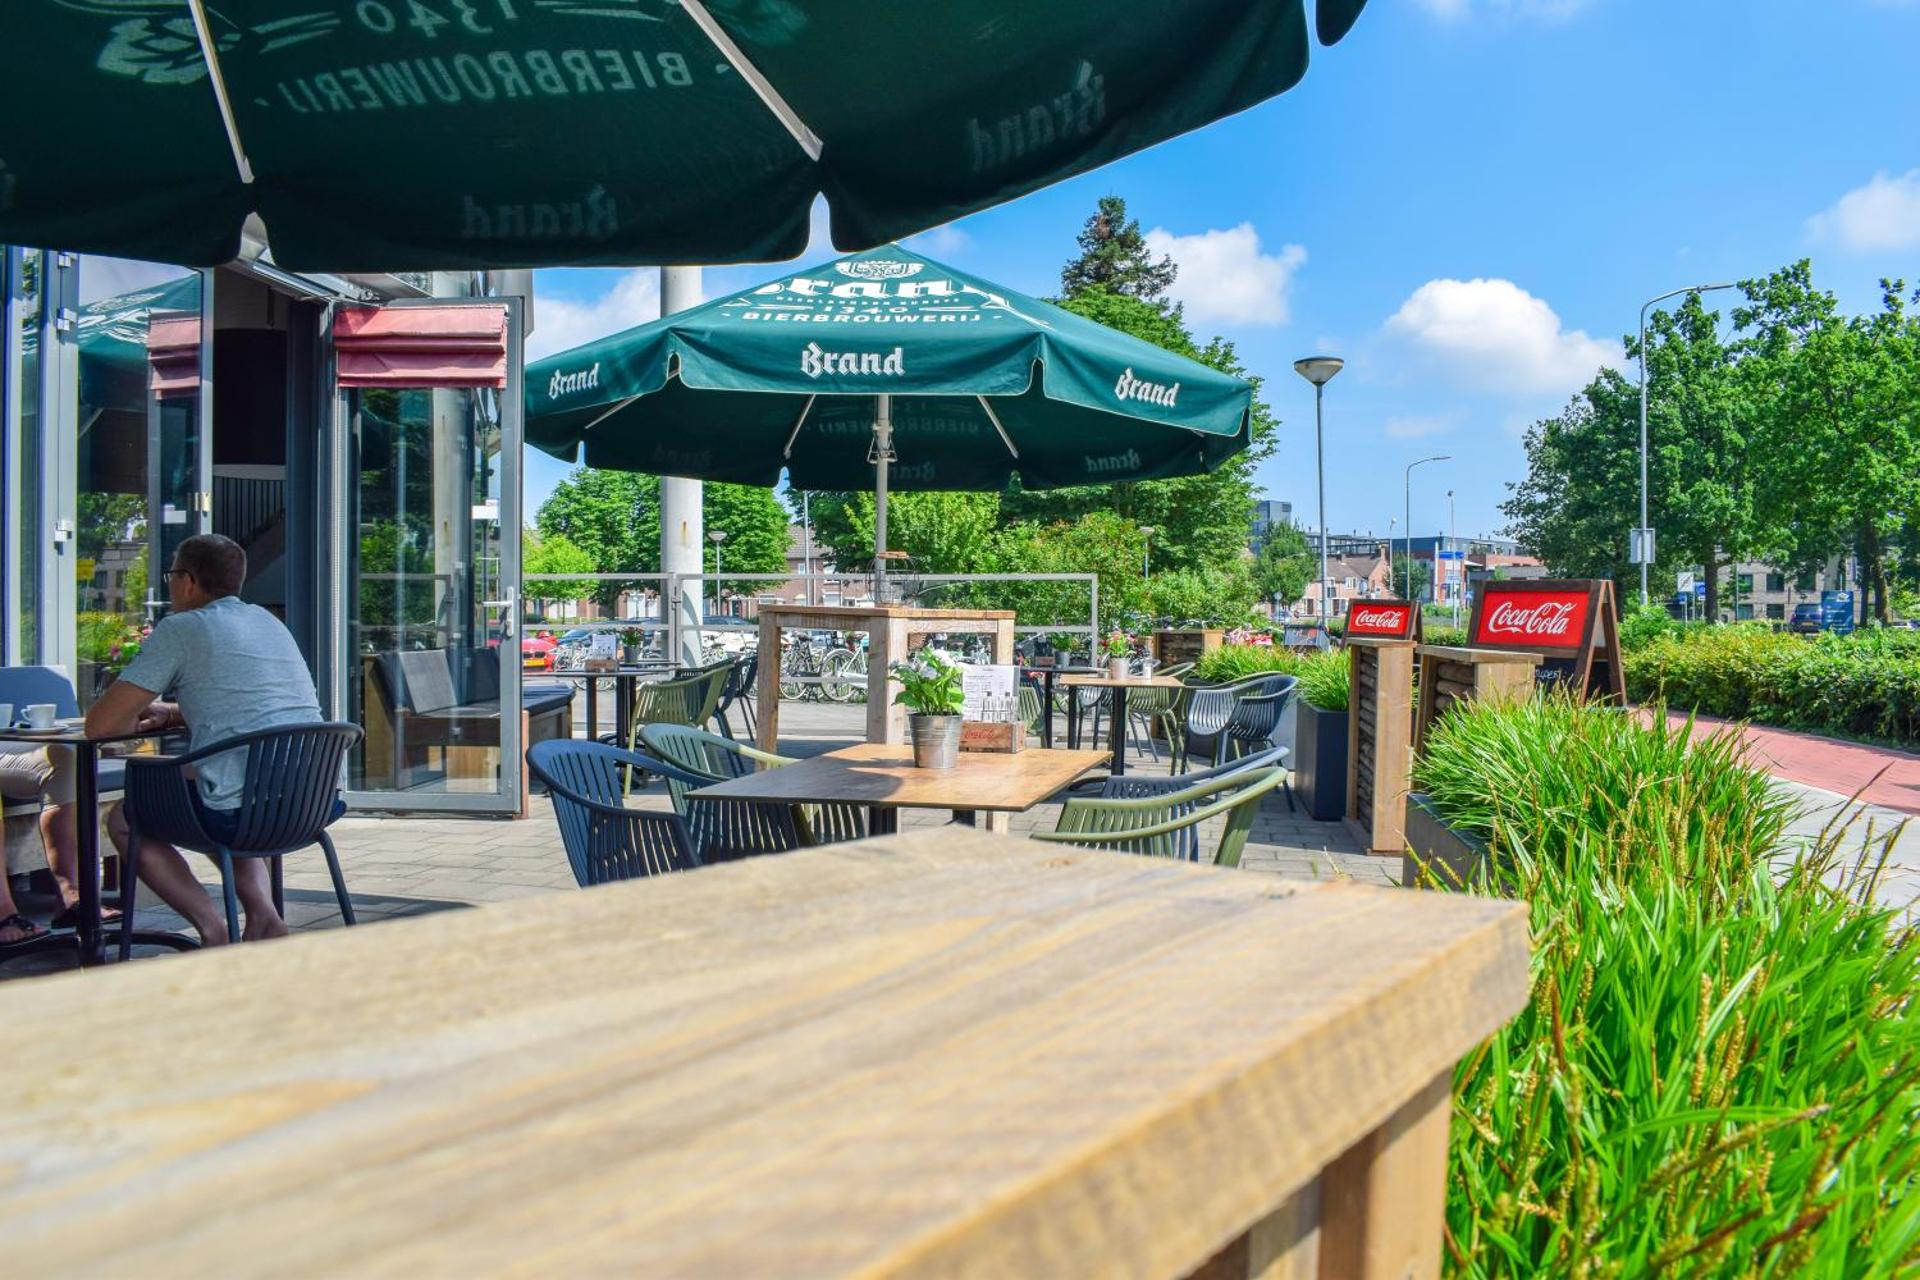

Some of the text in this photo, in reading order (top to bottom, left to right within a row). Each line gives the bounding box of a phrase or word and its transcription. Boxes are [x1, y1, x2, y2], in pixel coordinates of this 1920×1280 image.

[741, 310, 981, 323] BIERBROUWERIJ
[822, 305, 909, 316] 1340
[801, 341, 905, 379] Brand
[548, 362, 600, 400] Brand
[1114, 367, 1180, 408] Brand
[1354, 609, 1404, 628] Coca-Cola
[1488, 600, 1577, 635] Coca-Cola
